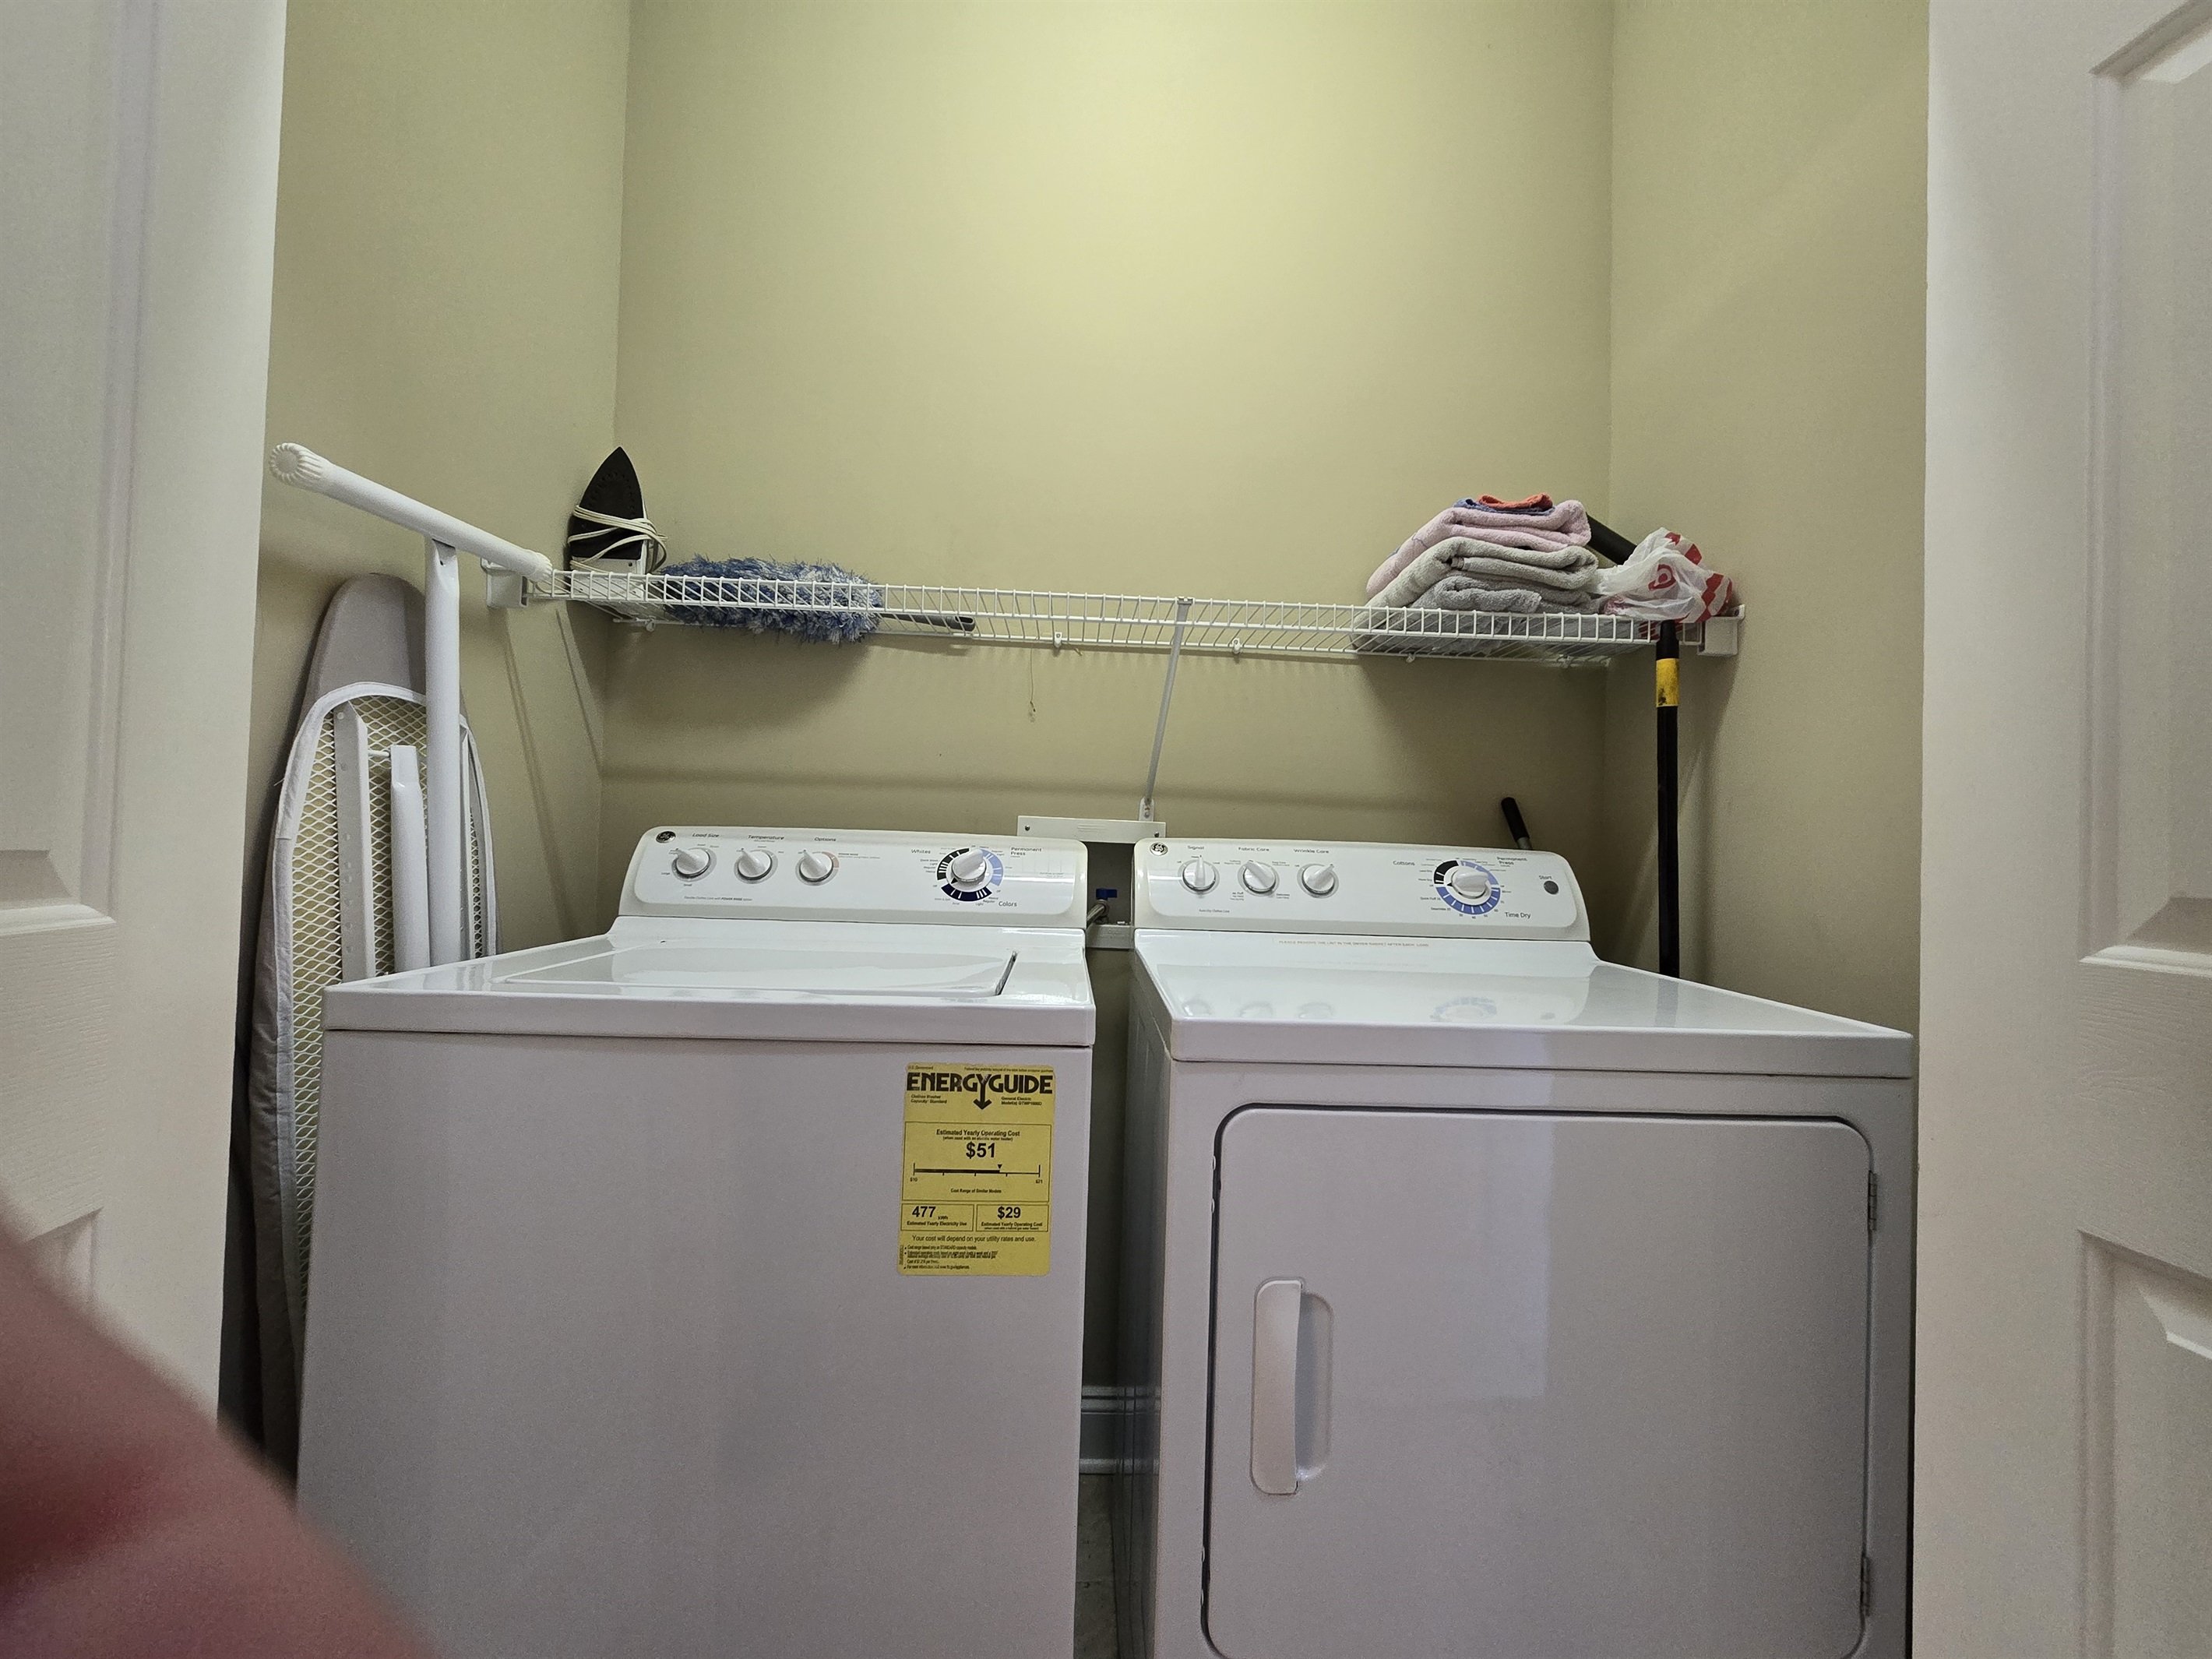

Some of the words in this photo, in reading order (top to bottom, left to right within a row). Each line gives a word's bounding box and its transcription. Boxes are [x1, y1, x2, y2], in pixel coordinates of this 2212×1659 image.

[907, 1073, 1053, 1094] ENERGYGUIDE
[966, 1141, 995, 1160] $51
[912, 1206, 936, 1218] 477
[997, 1206, 1021, 1220] $29
